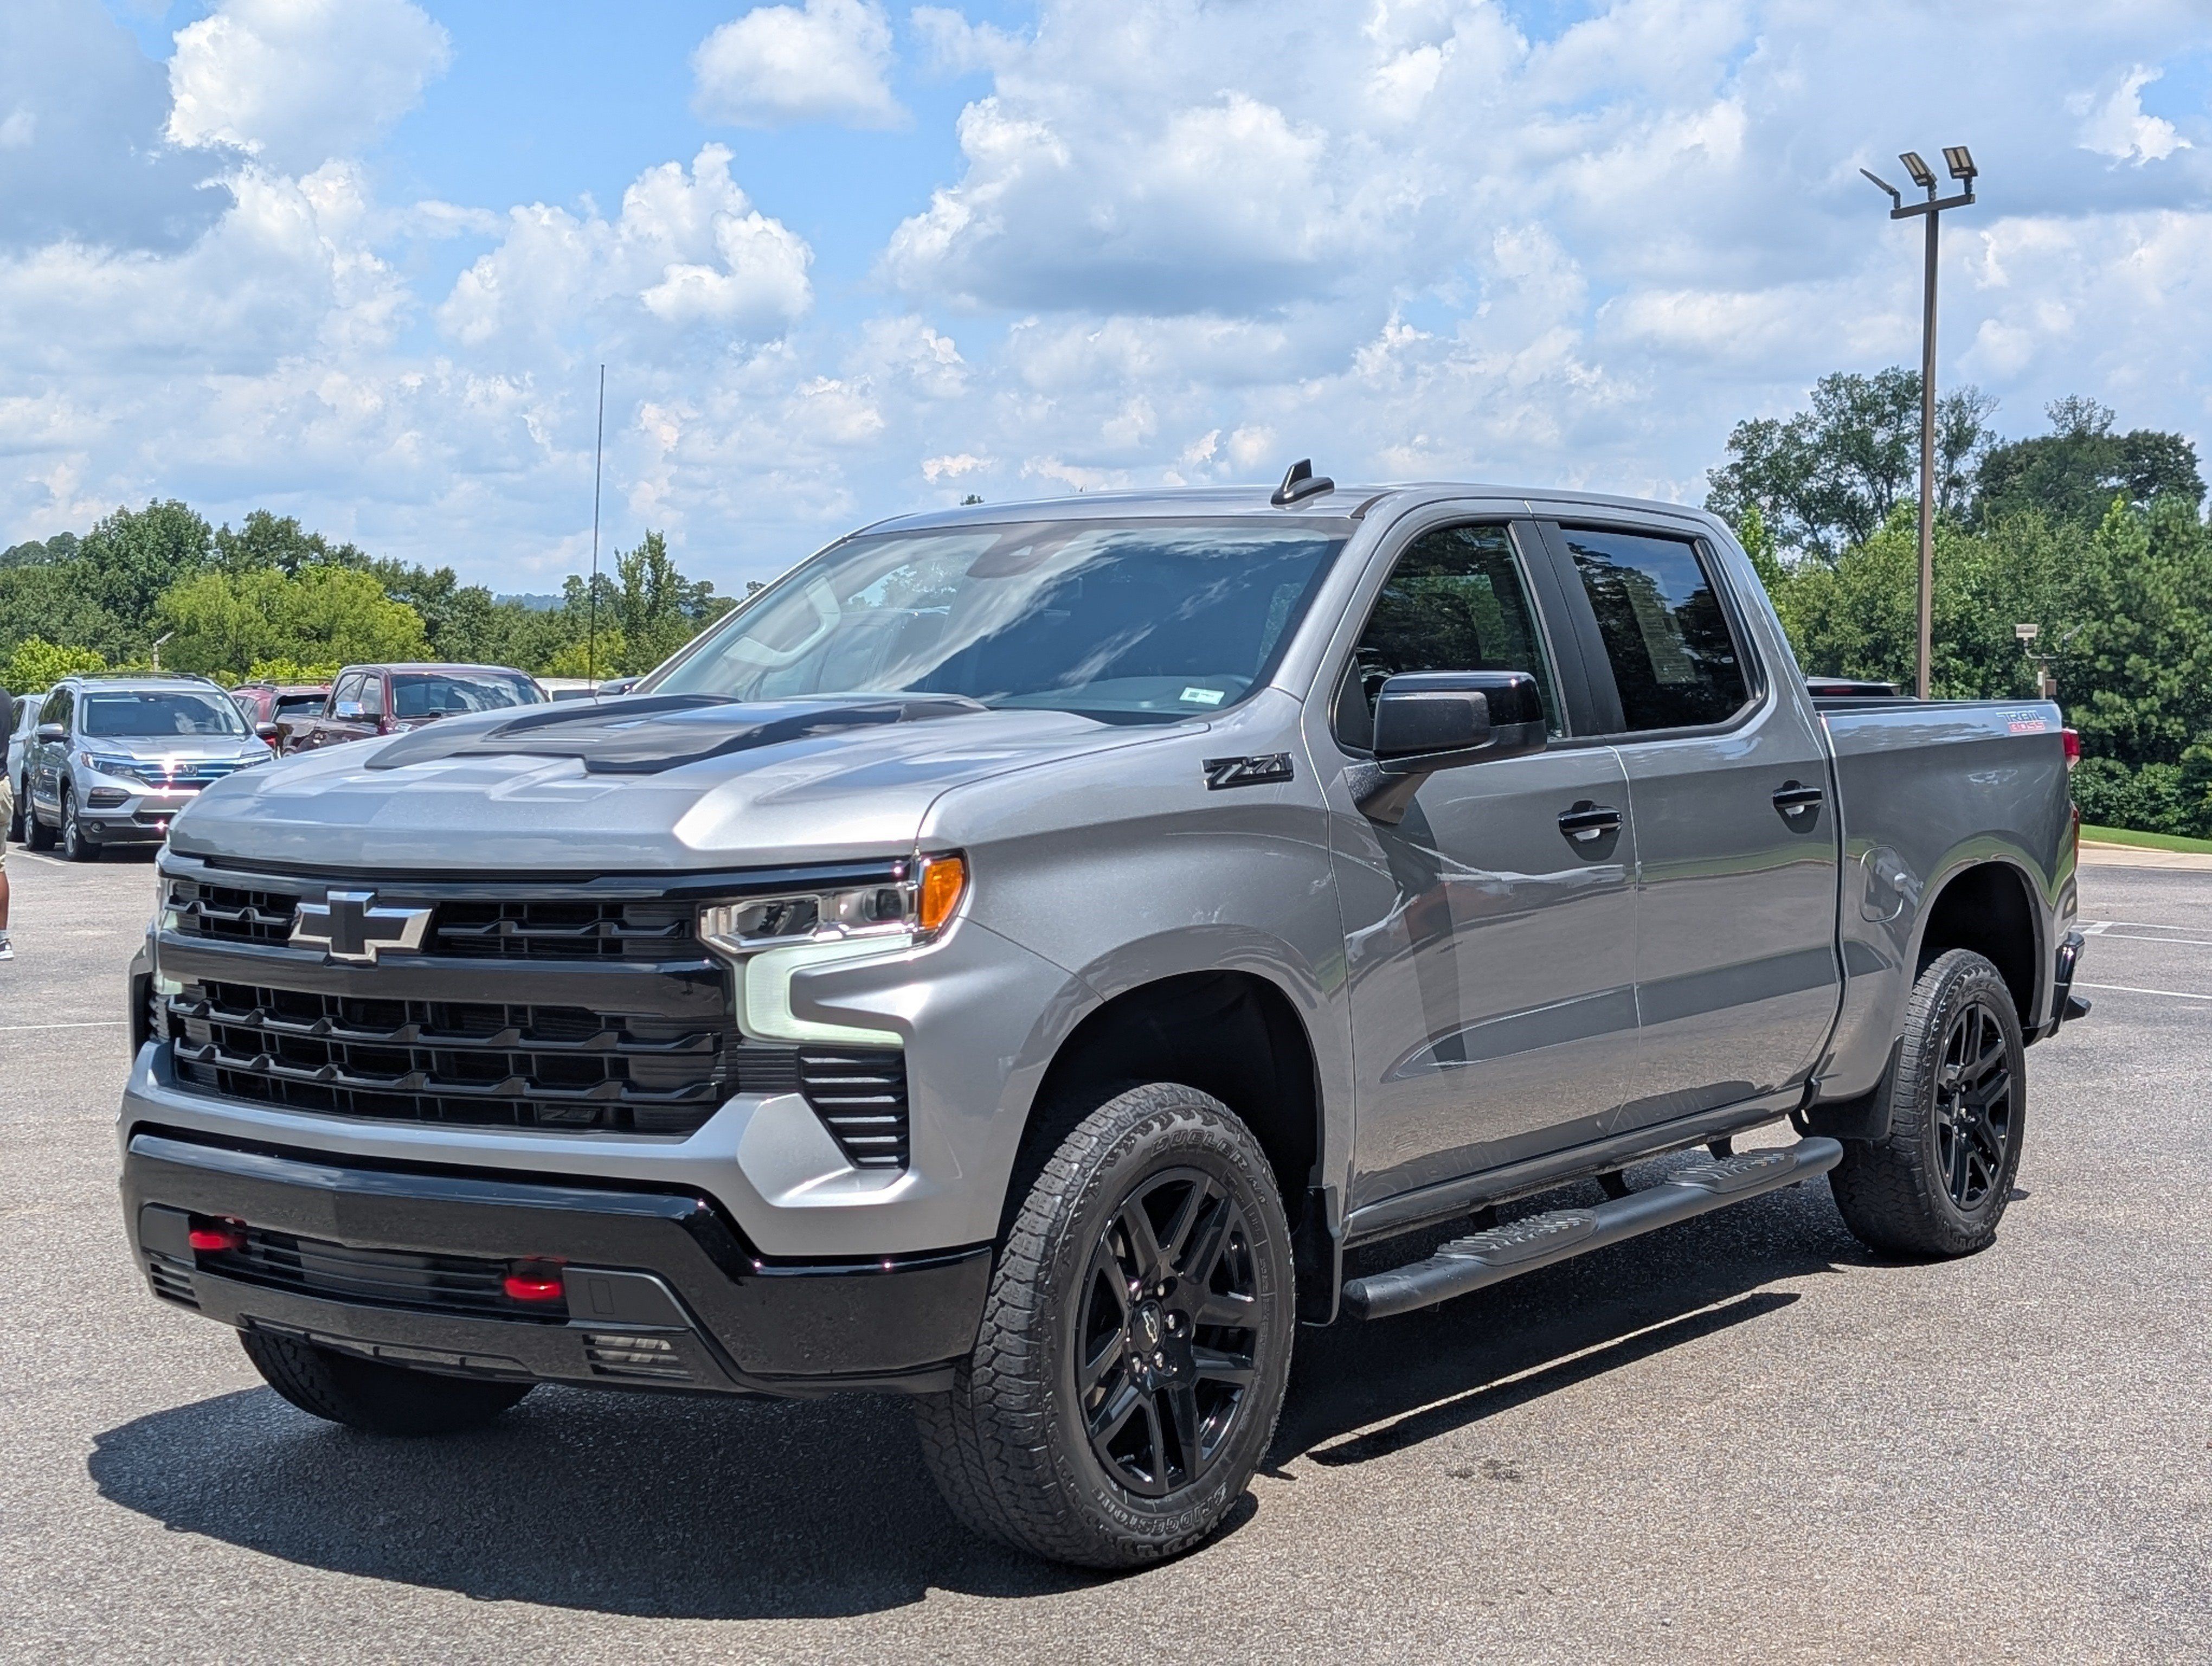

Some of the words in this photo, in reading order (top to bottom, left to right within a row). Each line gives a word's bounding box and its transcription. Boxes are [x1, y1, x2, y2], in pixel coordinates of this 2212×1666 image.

[1996, 710, 2046, 722] TRAIL
[2009, 721, 2046, 732] BOSS
[1202, 752, 1294, 790] Z71
